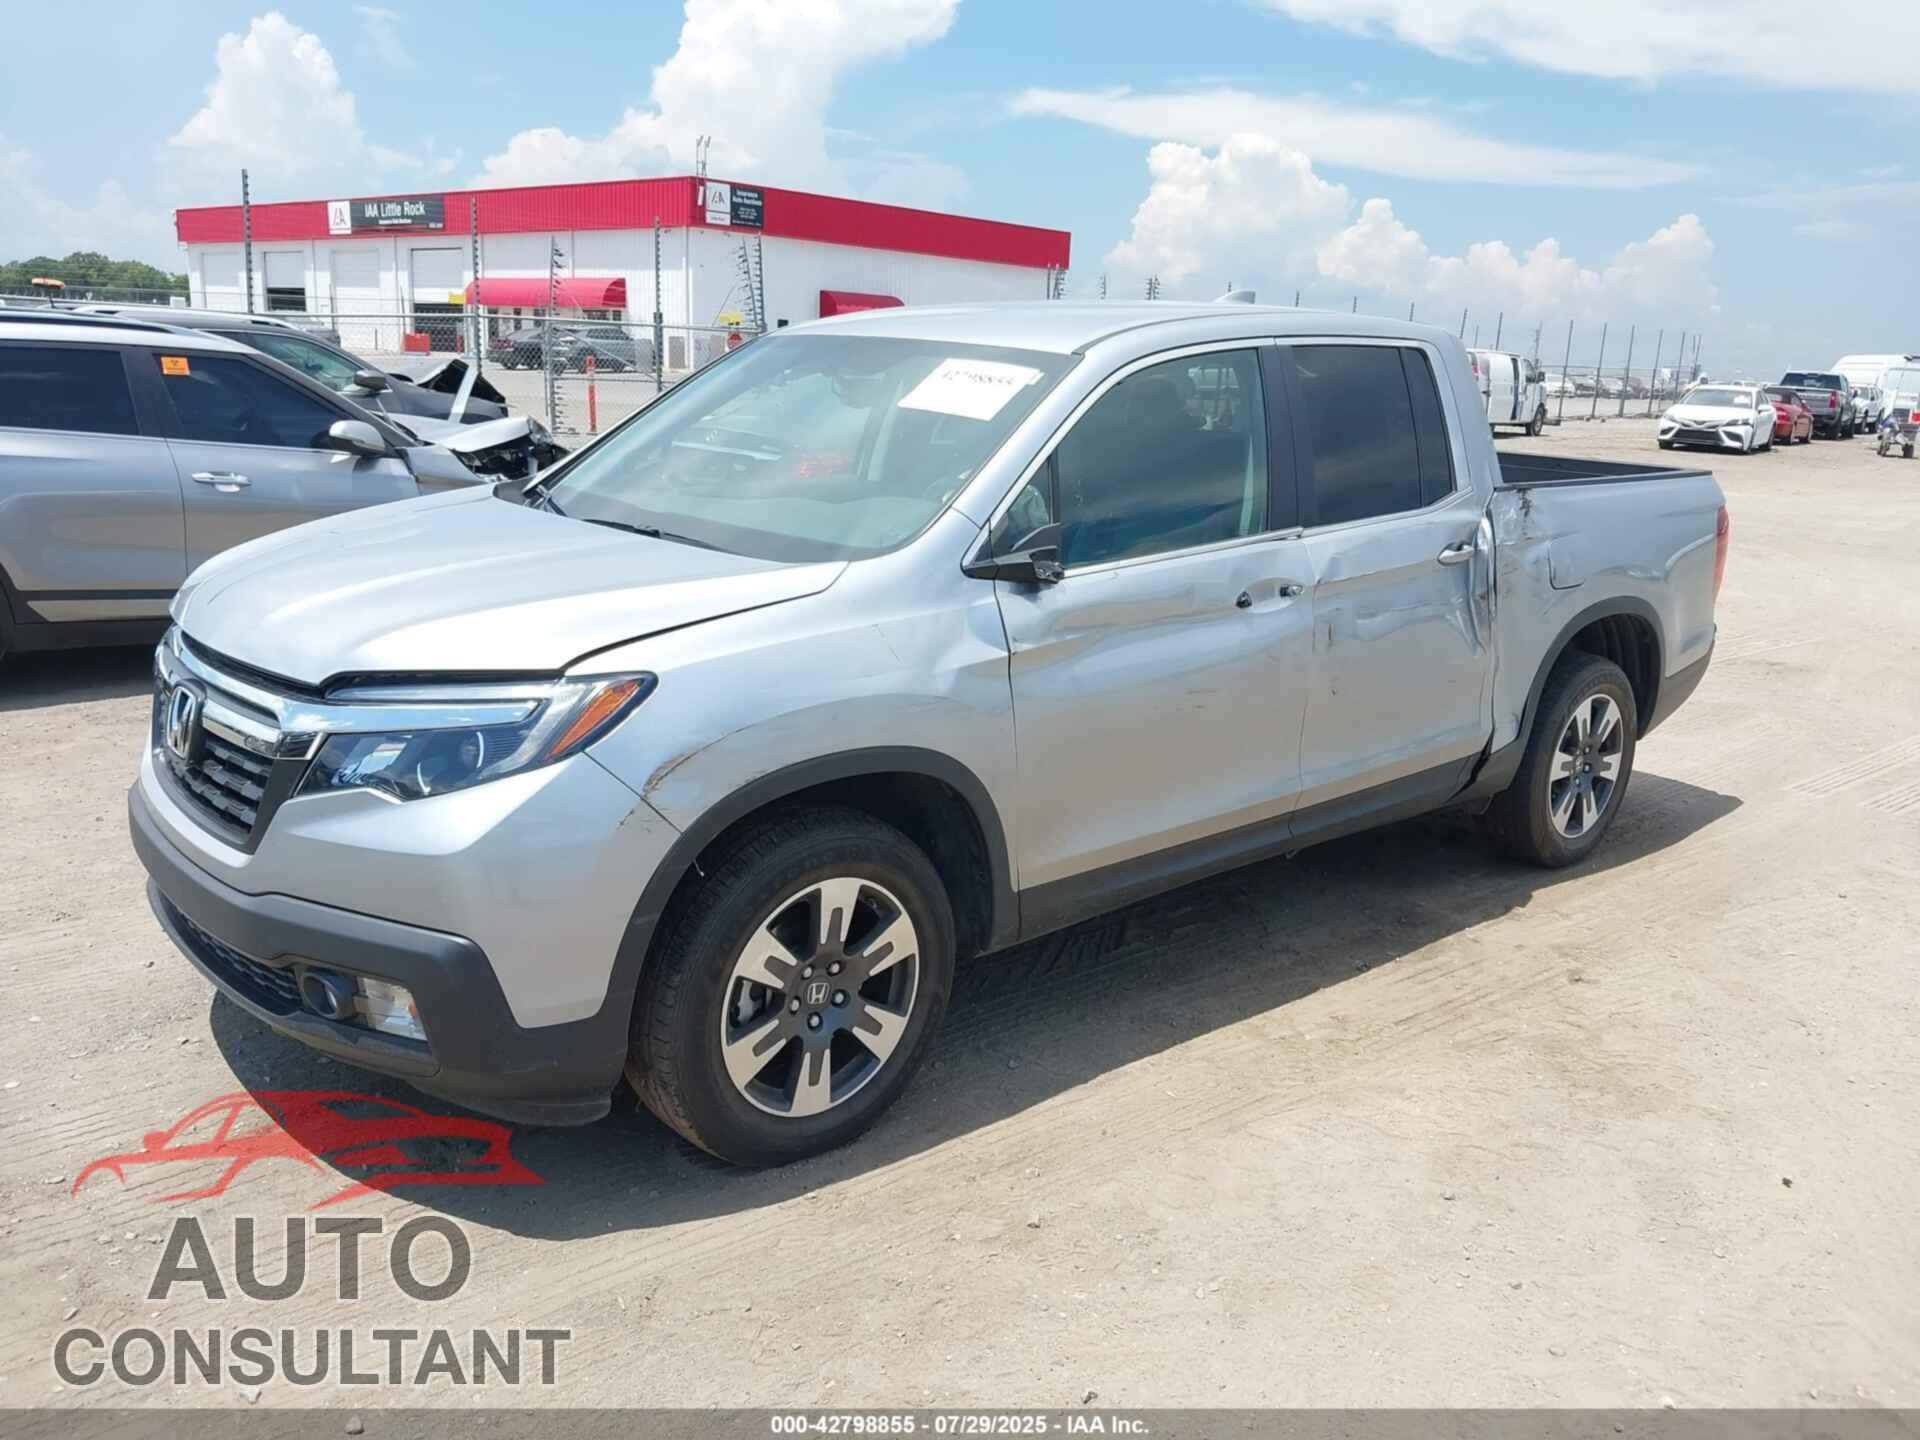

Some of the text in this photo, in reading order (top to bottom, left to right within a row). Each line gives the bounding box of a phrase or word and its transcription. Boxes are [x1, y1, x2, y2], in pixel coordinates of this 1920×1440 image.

[364, 201, 426, 218] IAA Little Rock
